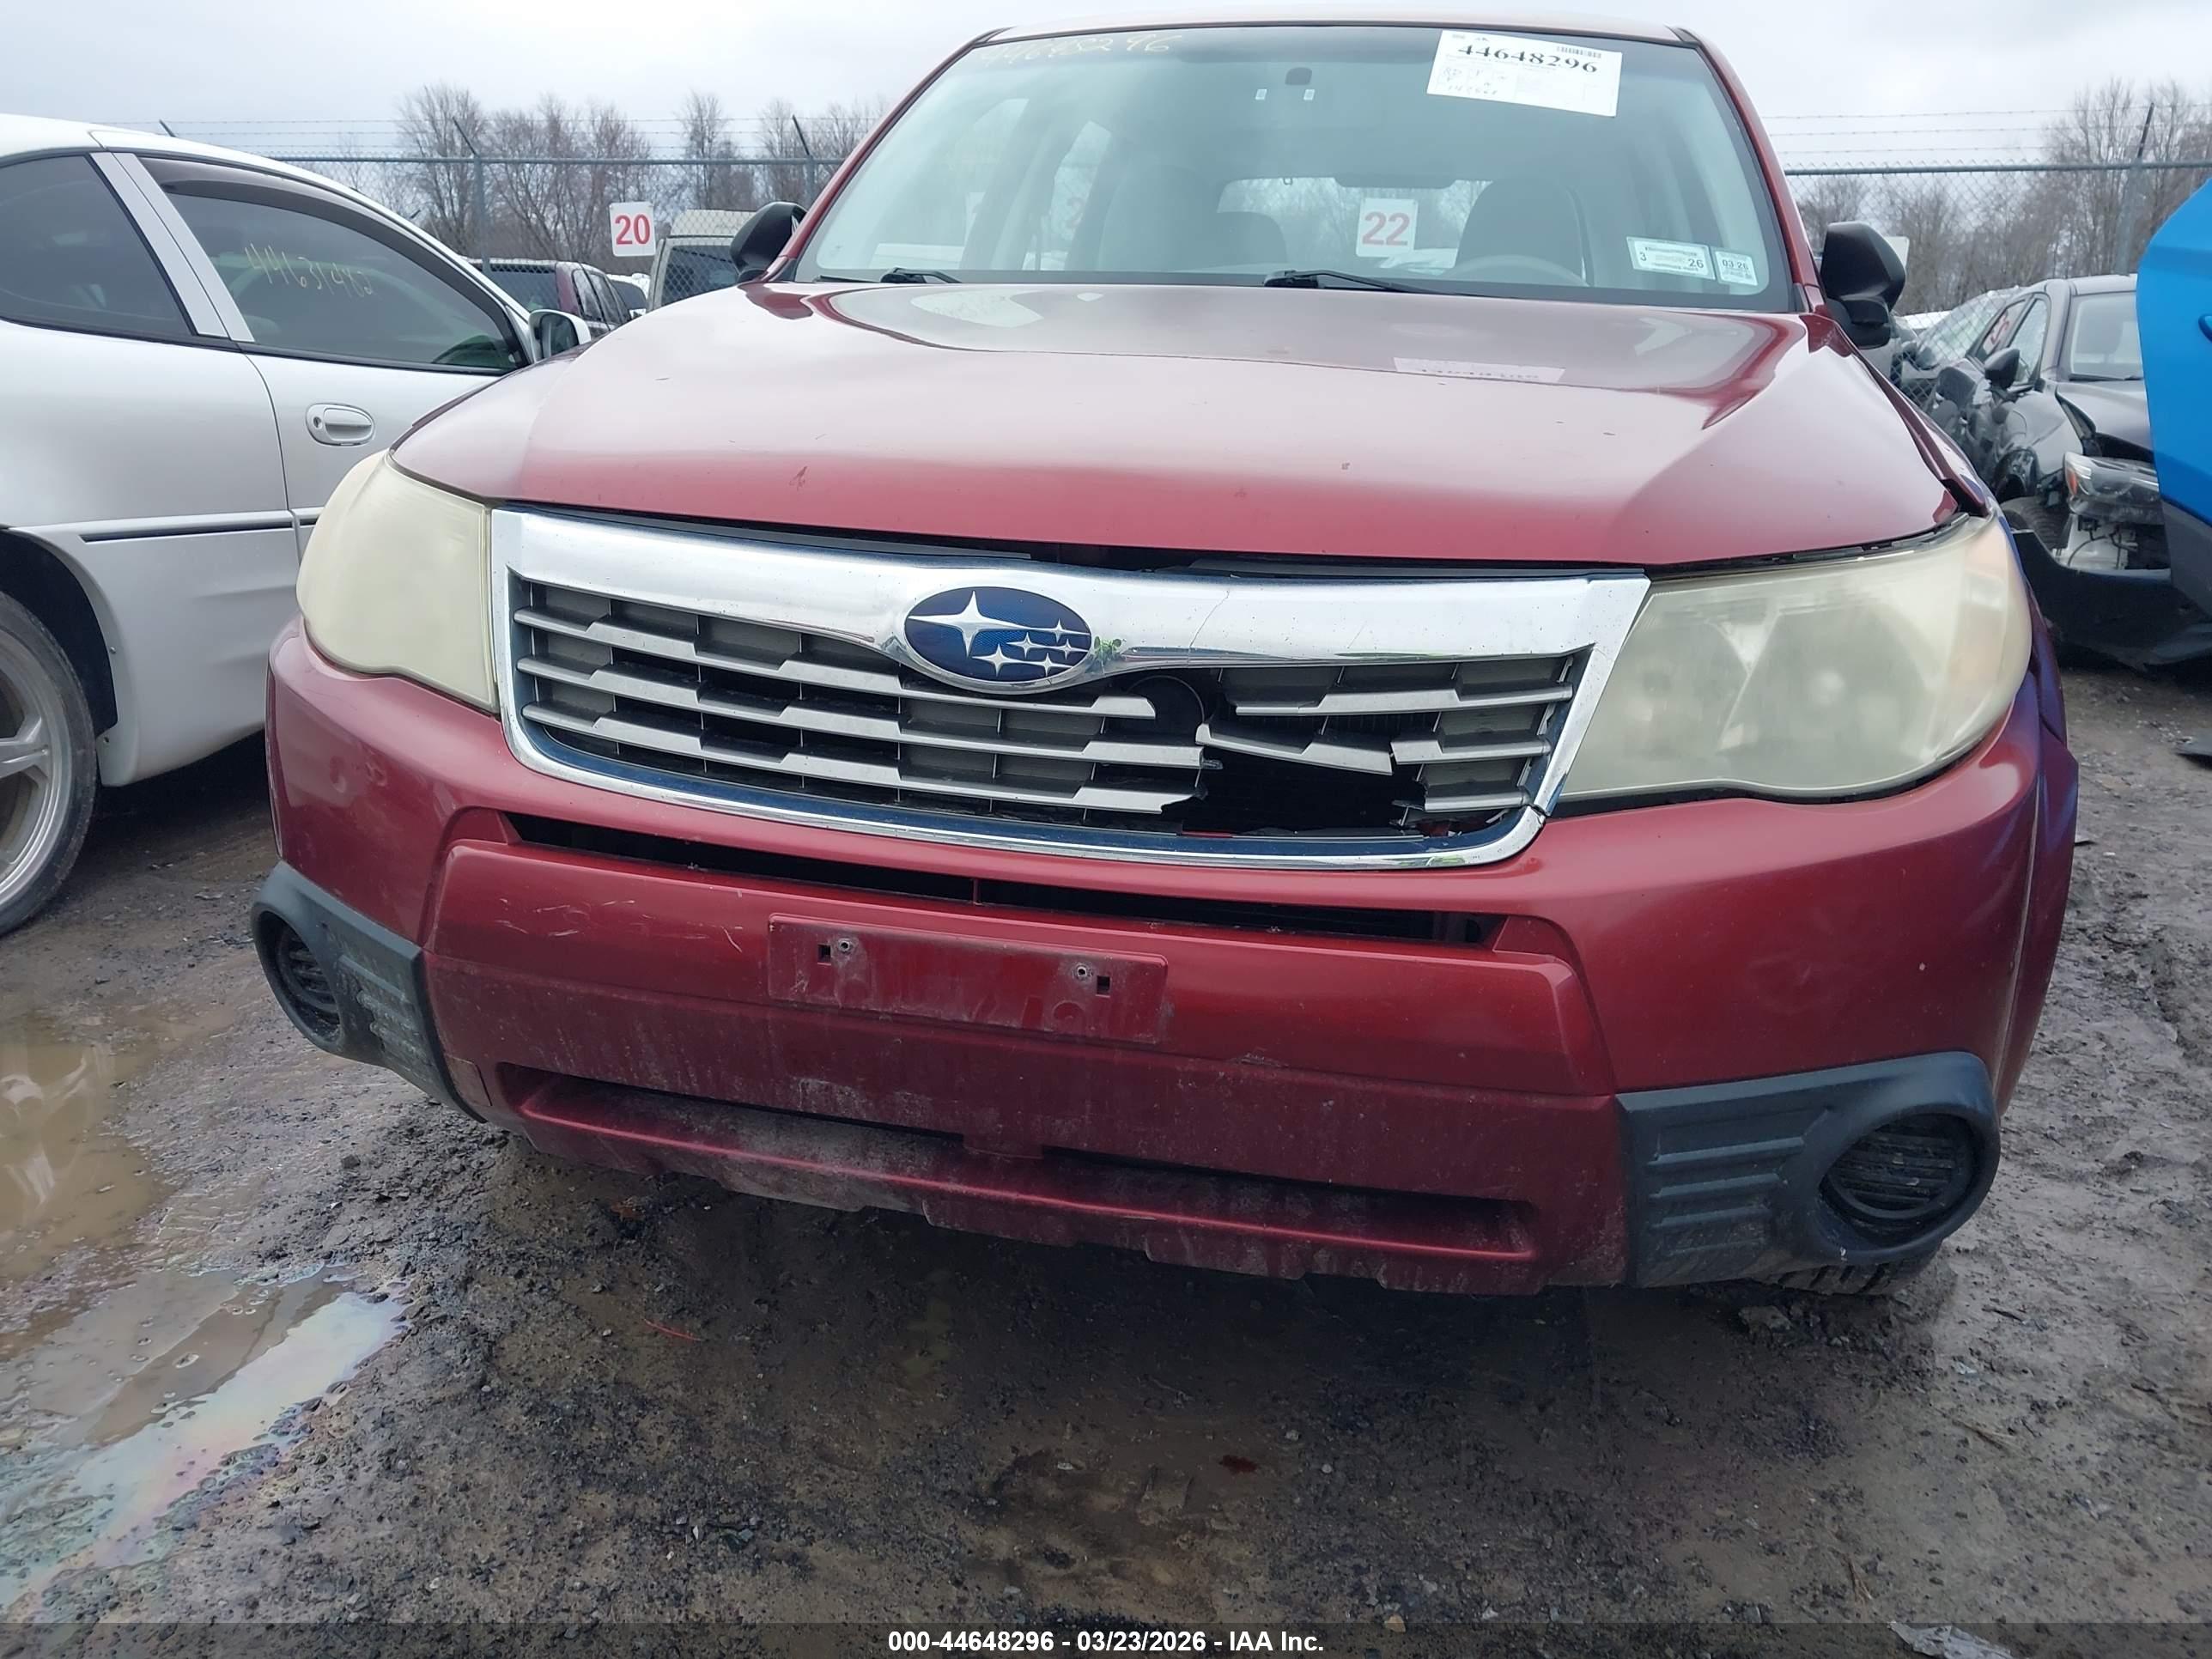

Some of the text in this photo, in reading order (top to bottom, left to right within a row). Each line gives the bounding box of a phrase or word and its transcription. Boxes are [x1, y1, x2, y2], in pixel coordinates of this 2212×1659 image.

[1457, 43, 1598, 74] 44648296
[615, 214, 650, 245] 20
[1362, 211, 1410, 246] 22
[1639, 251, 1648, 262] 3
[1688, 258, 1705, 269] 26
